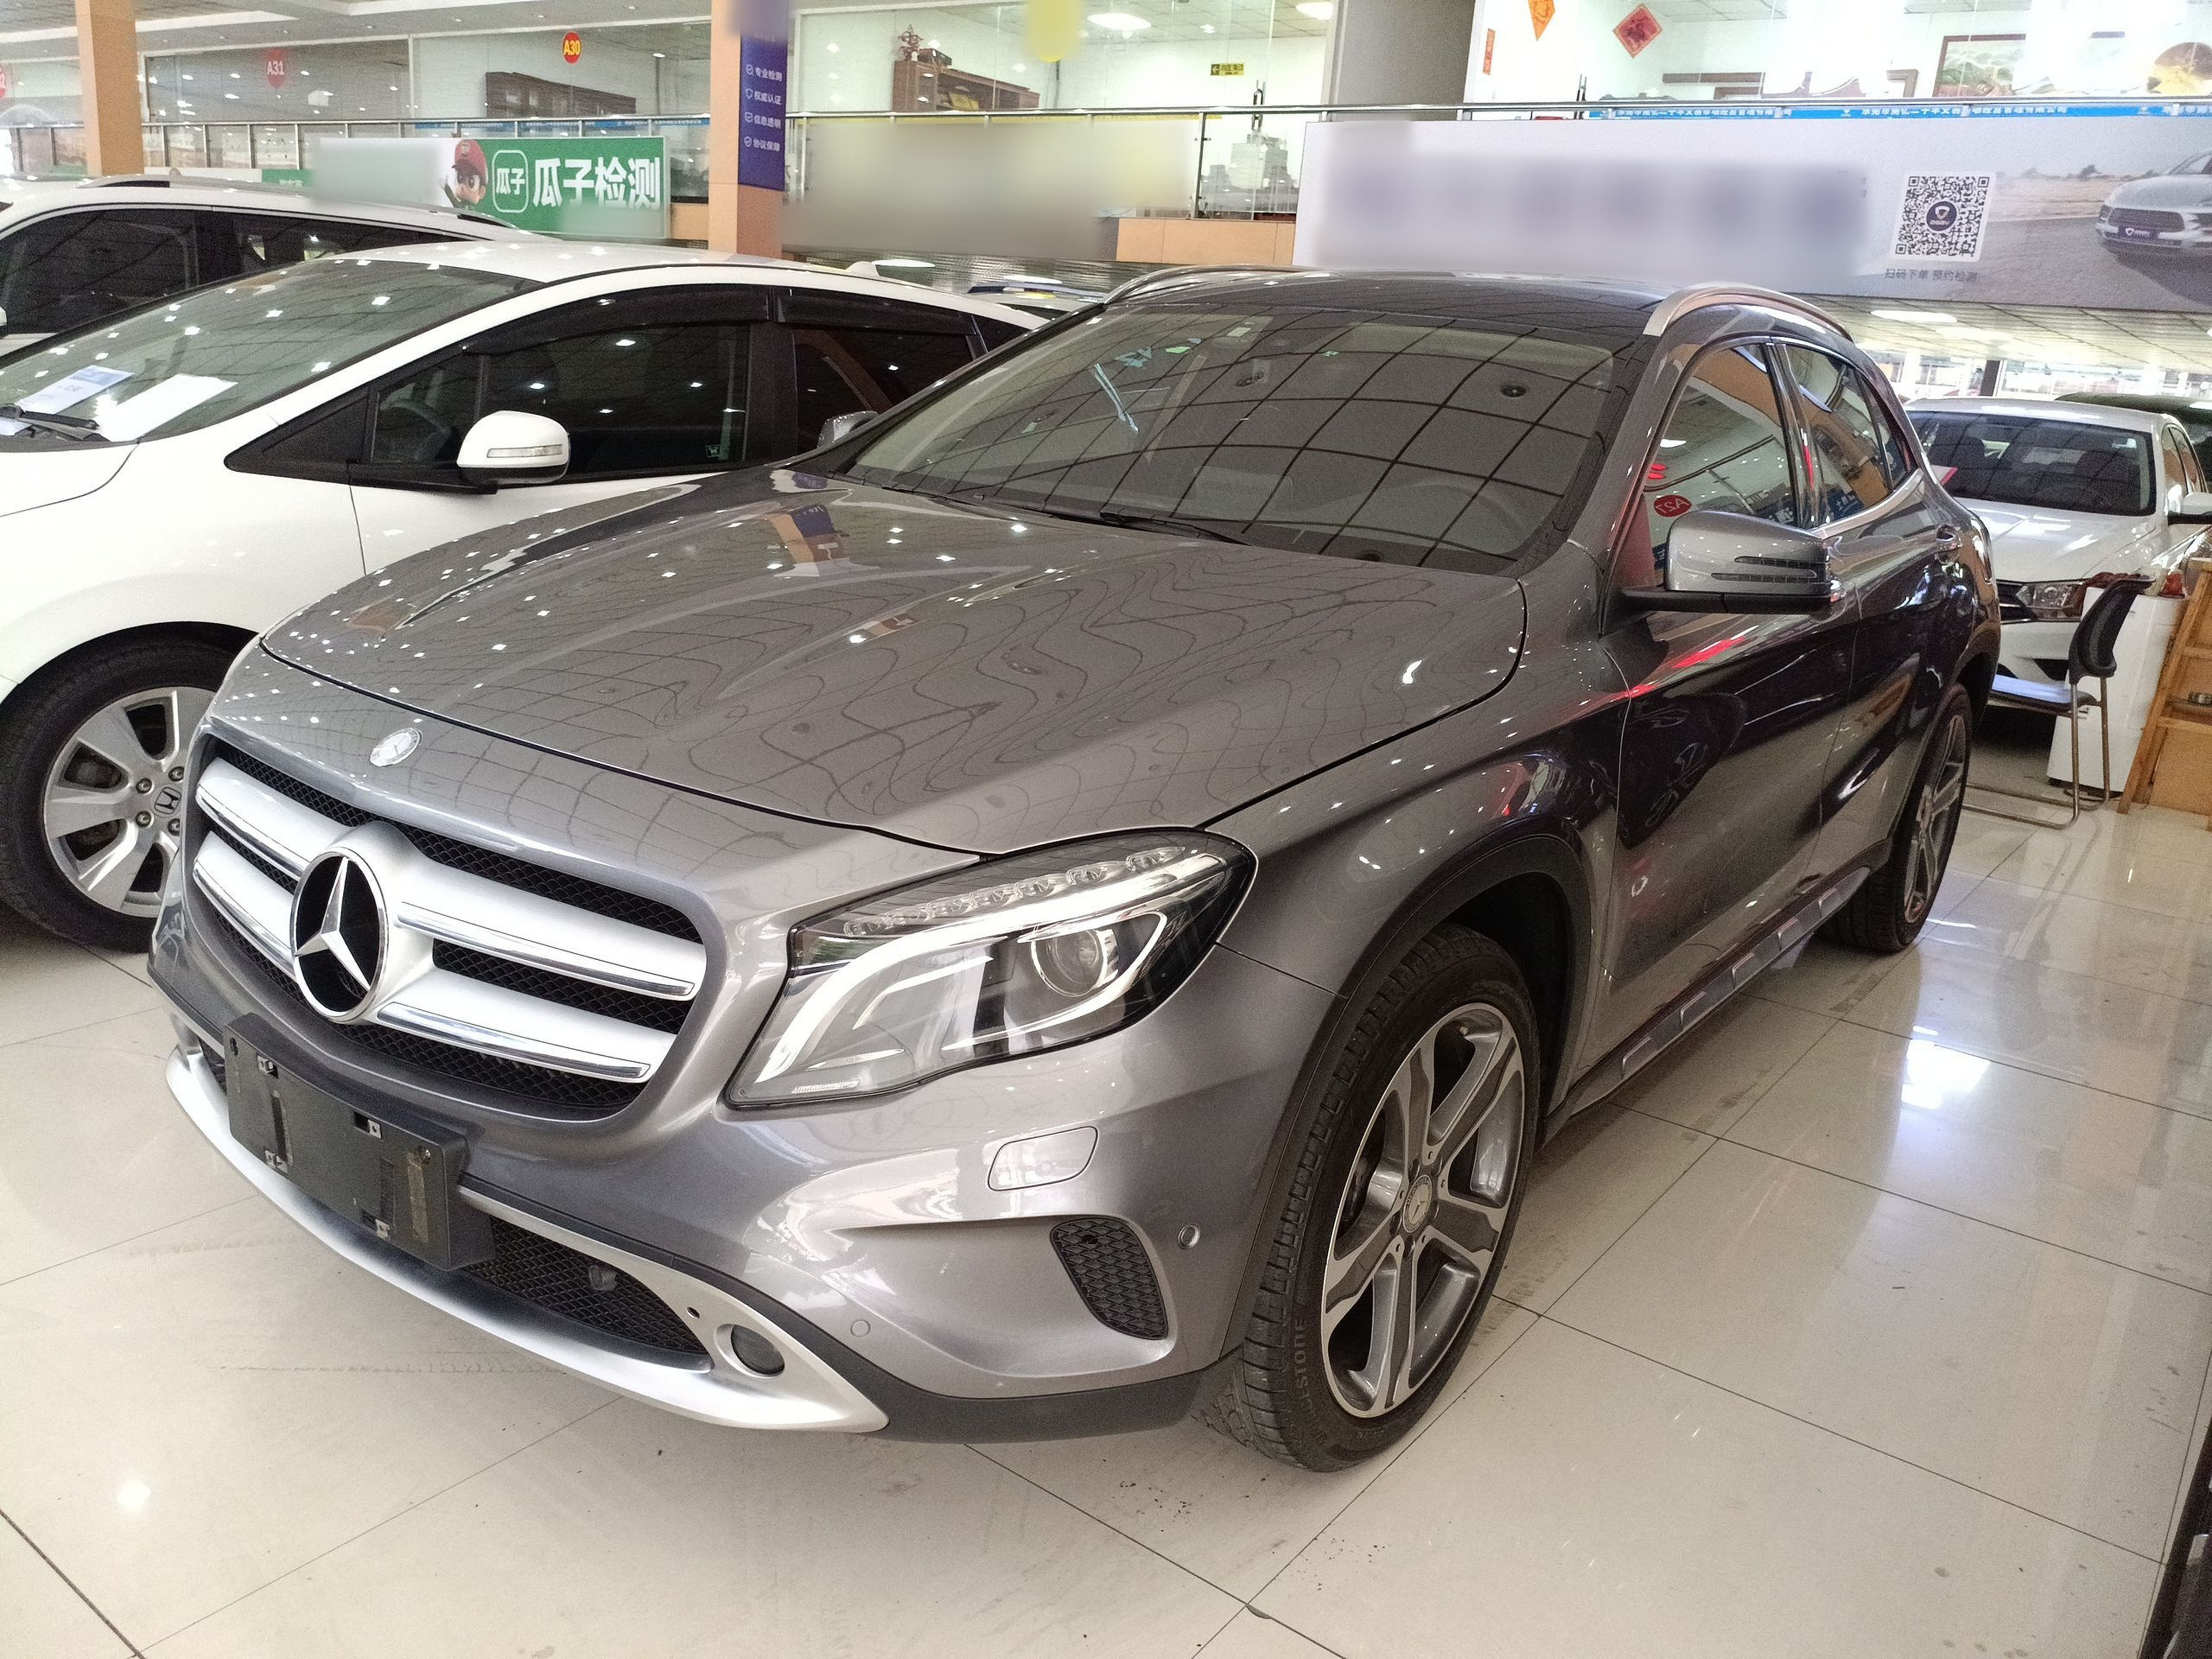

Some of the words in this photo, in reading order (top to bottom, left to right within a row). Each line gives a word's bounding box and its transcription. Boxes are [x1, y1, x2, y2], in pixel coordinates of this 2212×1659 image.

[564, 40, 581, 56] A30
[267, 60, 285, 75] A31
[755, 67, 782, 82] 专业检测
[754, 90, 782, 105] 权威认证
[753, 115, 781, 129] 信息透明
[753, 138, 781, 152] 协议保障
[496, 168, 525, 195] 瓜子
[533, 156, 661, 210] 瓜子检测
[1884, 268, 1930, 280] 扫码下单
[1932, 269, 1978, 283] 预约检测
